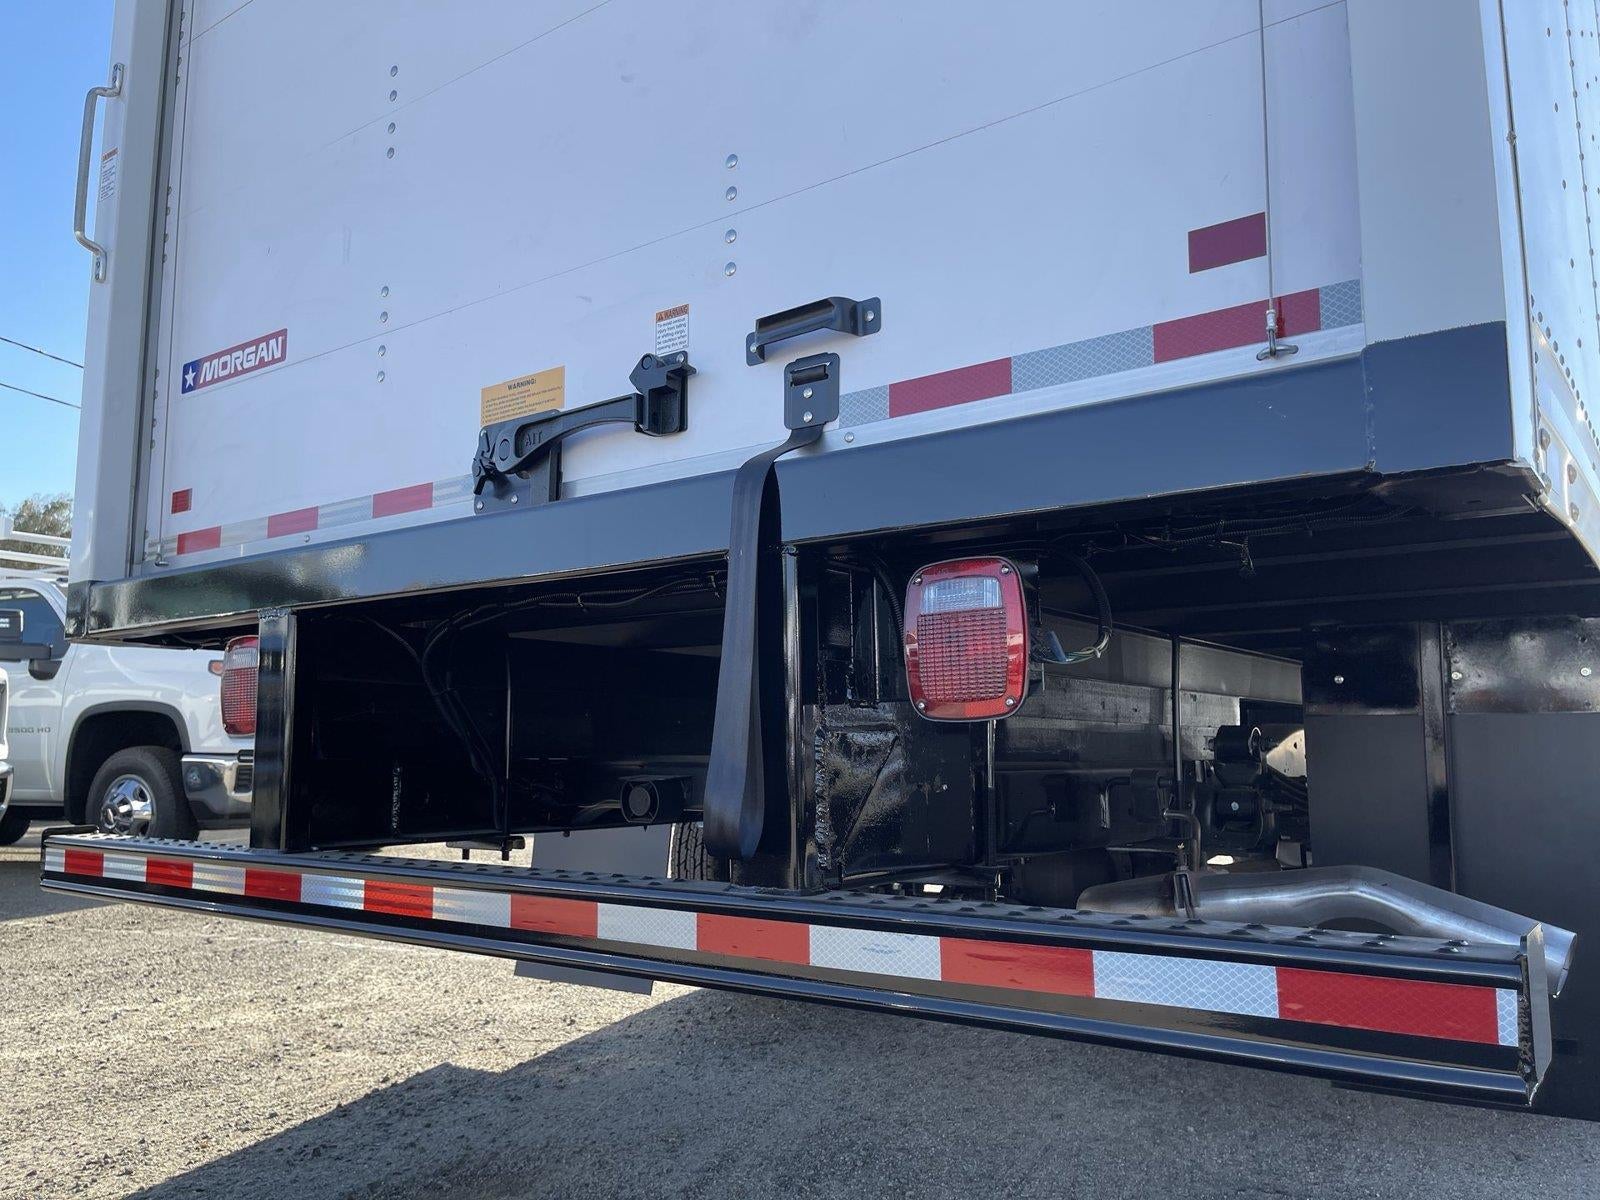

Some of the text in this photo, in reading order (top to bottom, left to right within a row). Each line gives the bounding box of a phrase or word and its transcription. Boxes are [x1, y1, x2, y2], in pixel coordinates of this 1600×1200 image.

[663, 305, 688, 319] WARNING
[200, 336, 282, 383] MORGAN
[37, 726, 51, 734] HD
